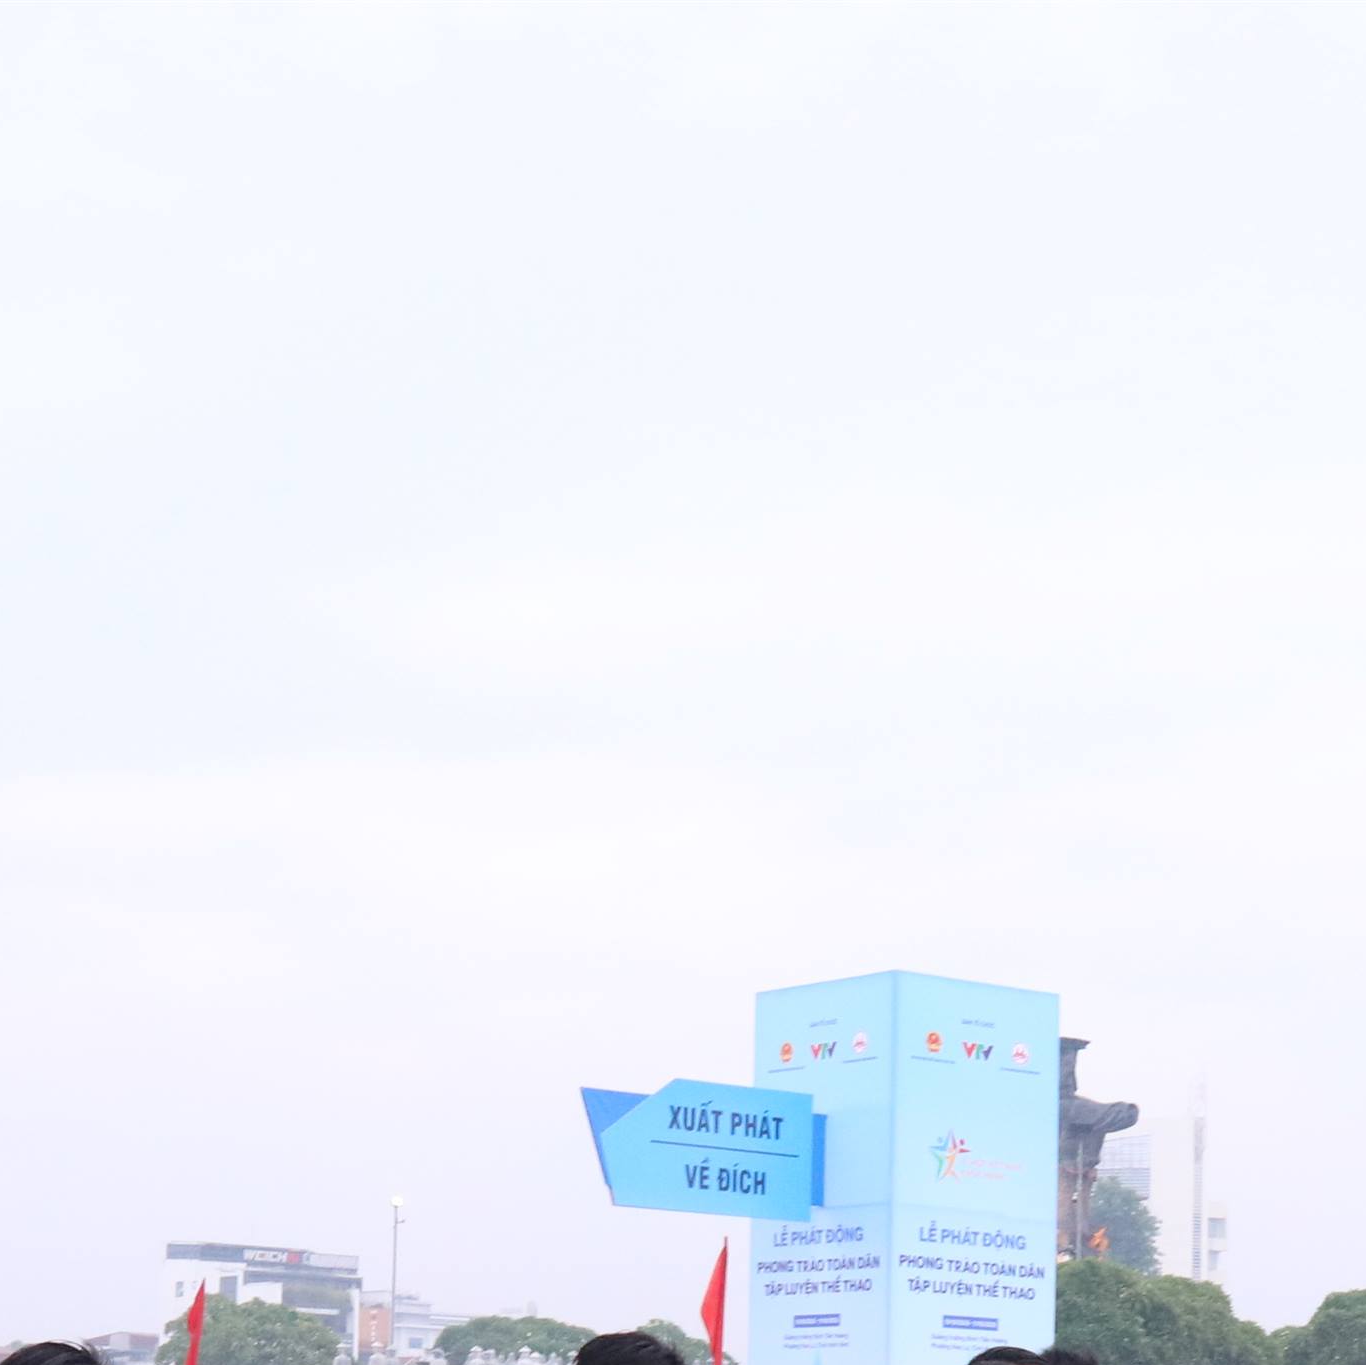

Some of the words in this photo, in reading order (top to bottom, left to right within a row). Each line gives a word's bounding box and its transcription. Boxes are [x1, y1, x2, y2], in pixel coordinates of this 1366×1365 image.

[810, 1041, 837, 1060] VTV
[962, 1041, 994, 1061] VTV
[669, 1100, 723, 1133] XUẤT
[730, 1110, 784, 1140] PHÁT
[717, 1163, 766, 1195] ĐÍCH
[791, 1226, 823, 1245] PHÁT
[941, 1227, 980, 1246] PHÁT
[983, 1230, 1027, 1251] ĐỘNG
[757, 1259, 794, 1274] PHONG
[898, 1254, 944, 1270] PHONG
[1019, 1262, 1045, 1279] DÂN
[1002, 1286, 1036, 1301] THAO
